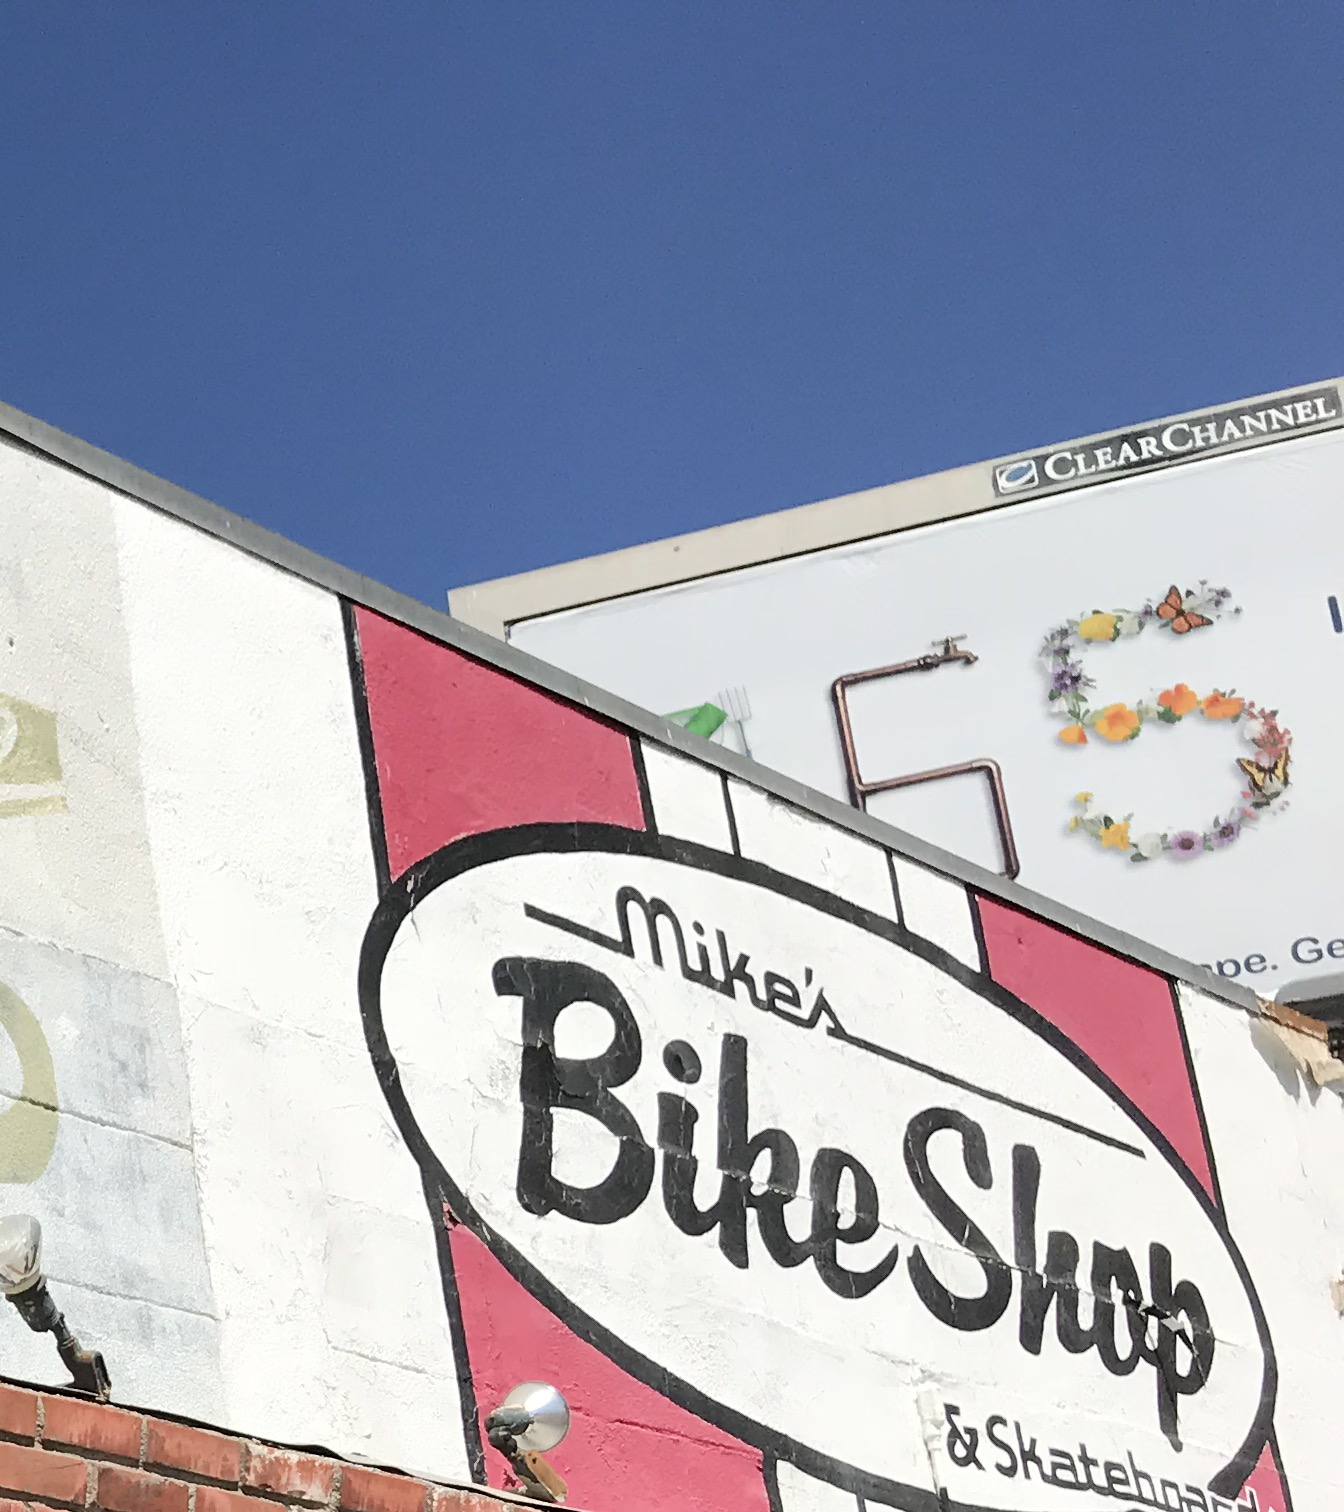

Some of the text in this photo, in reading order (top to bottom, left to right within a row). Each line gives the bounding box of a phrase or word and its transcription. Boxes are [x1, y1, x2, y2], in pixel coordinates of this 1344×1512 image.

[1201, 952, 1279, 979] pe.
[491, 956, 1214, 1452] Bike Shop
[943, 1403, 986, 1471] &
